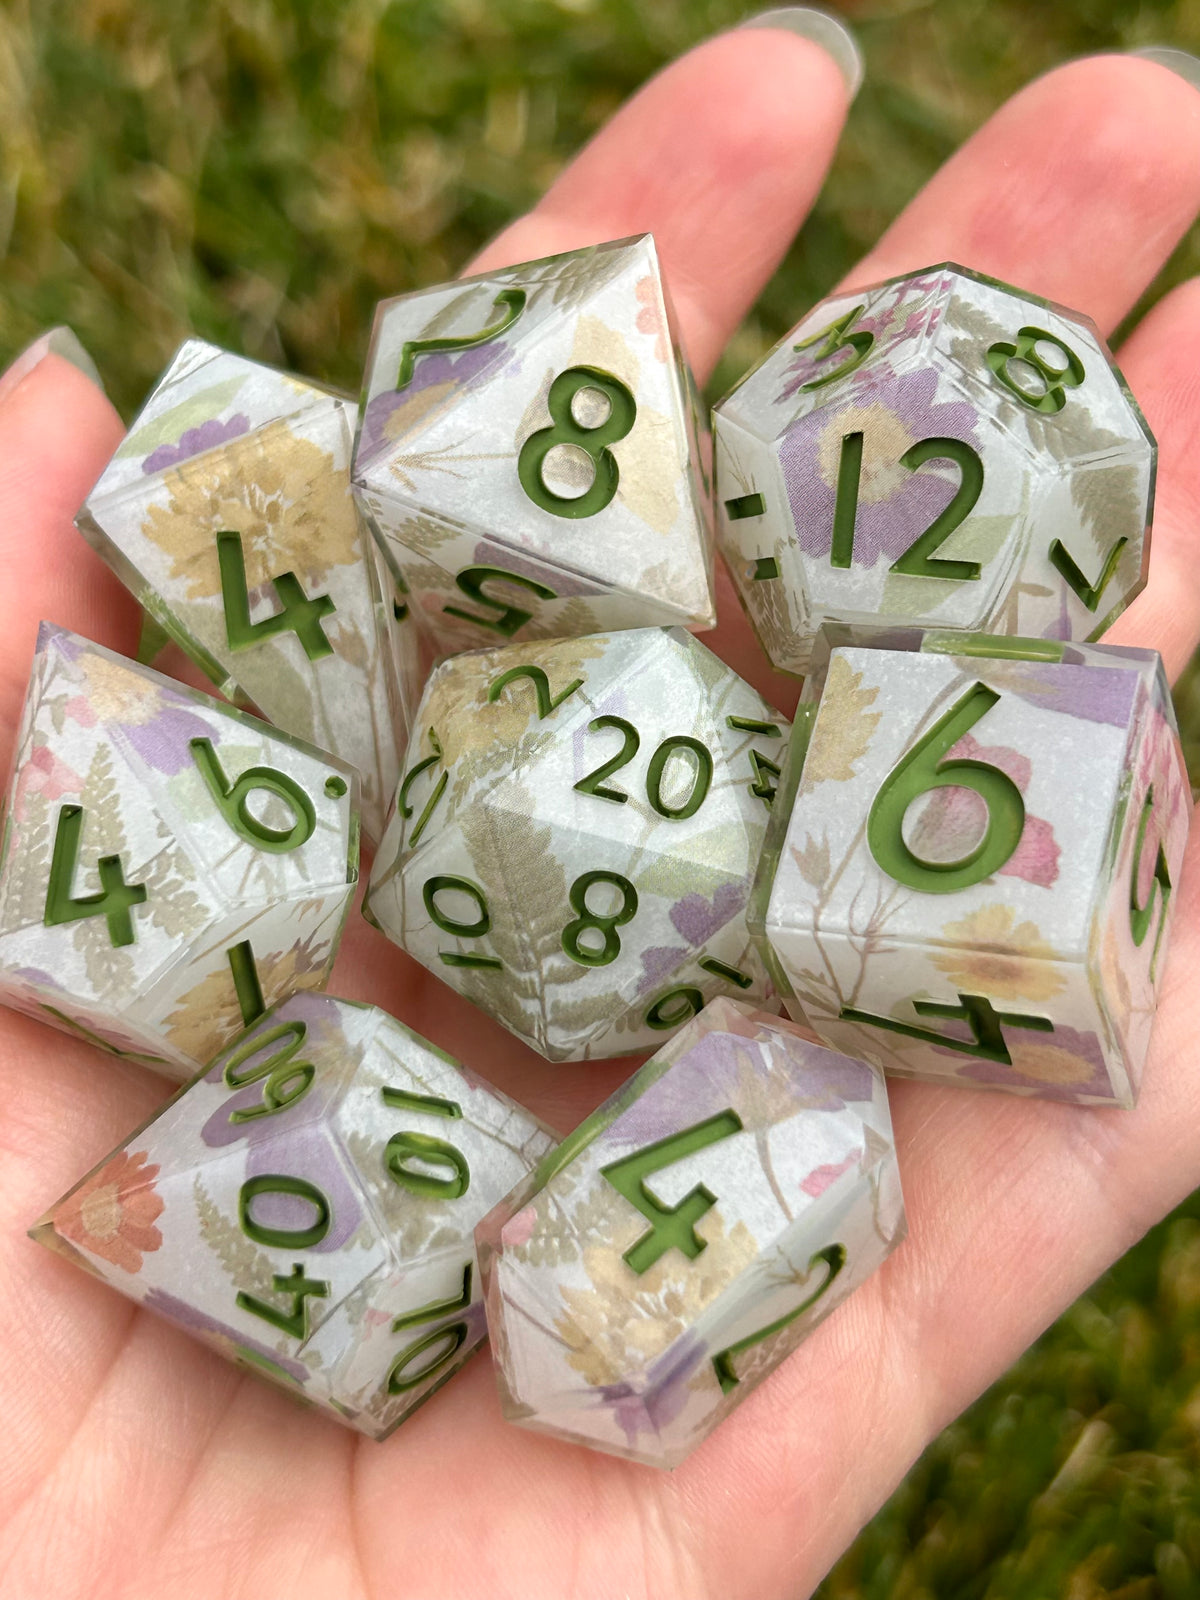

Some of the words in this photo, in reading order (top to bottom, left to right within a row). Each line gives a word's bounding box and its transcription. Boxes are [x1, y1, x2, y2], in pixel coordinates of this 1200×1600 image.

[397, 289, 527, 391] 2
[986, 326, 1085, 415] 8
[518, 365, 637, 519] 8
[829, 431, 985, 580] 12
[216, 531, 336, 661] 4
[443, 564, 558, 637] 5
[489, 665, 585, 719] 2
[574, 715, 713, 820] 20
[867, 681, 1025, 894] 6
[44, 804, 147, 949] 4
[422, 875, 503, 970] 10
[561, 870, 639, 967] 8
[839, 993, 1054, 1066] 4
[382, 1086, 471, 1200] 10
[600, 1107, 744, 1275] 4
[235, 1173, 332, 1341] 40
[388, 1260, 473, 1395] 70
[712, 1242, 847, 1396] 2
